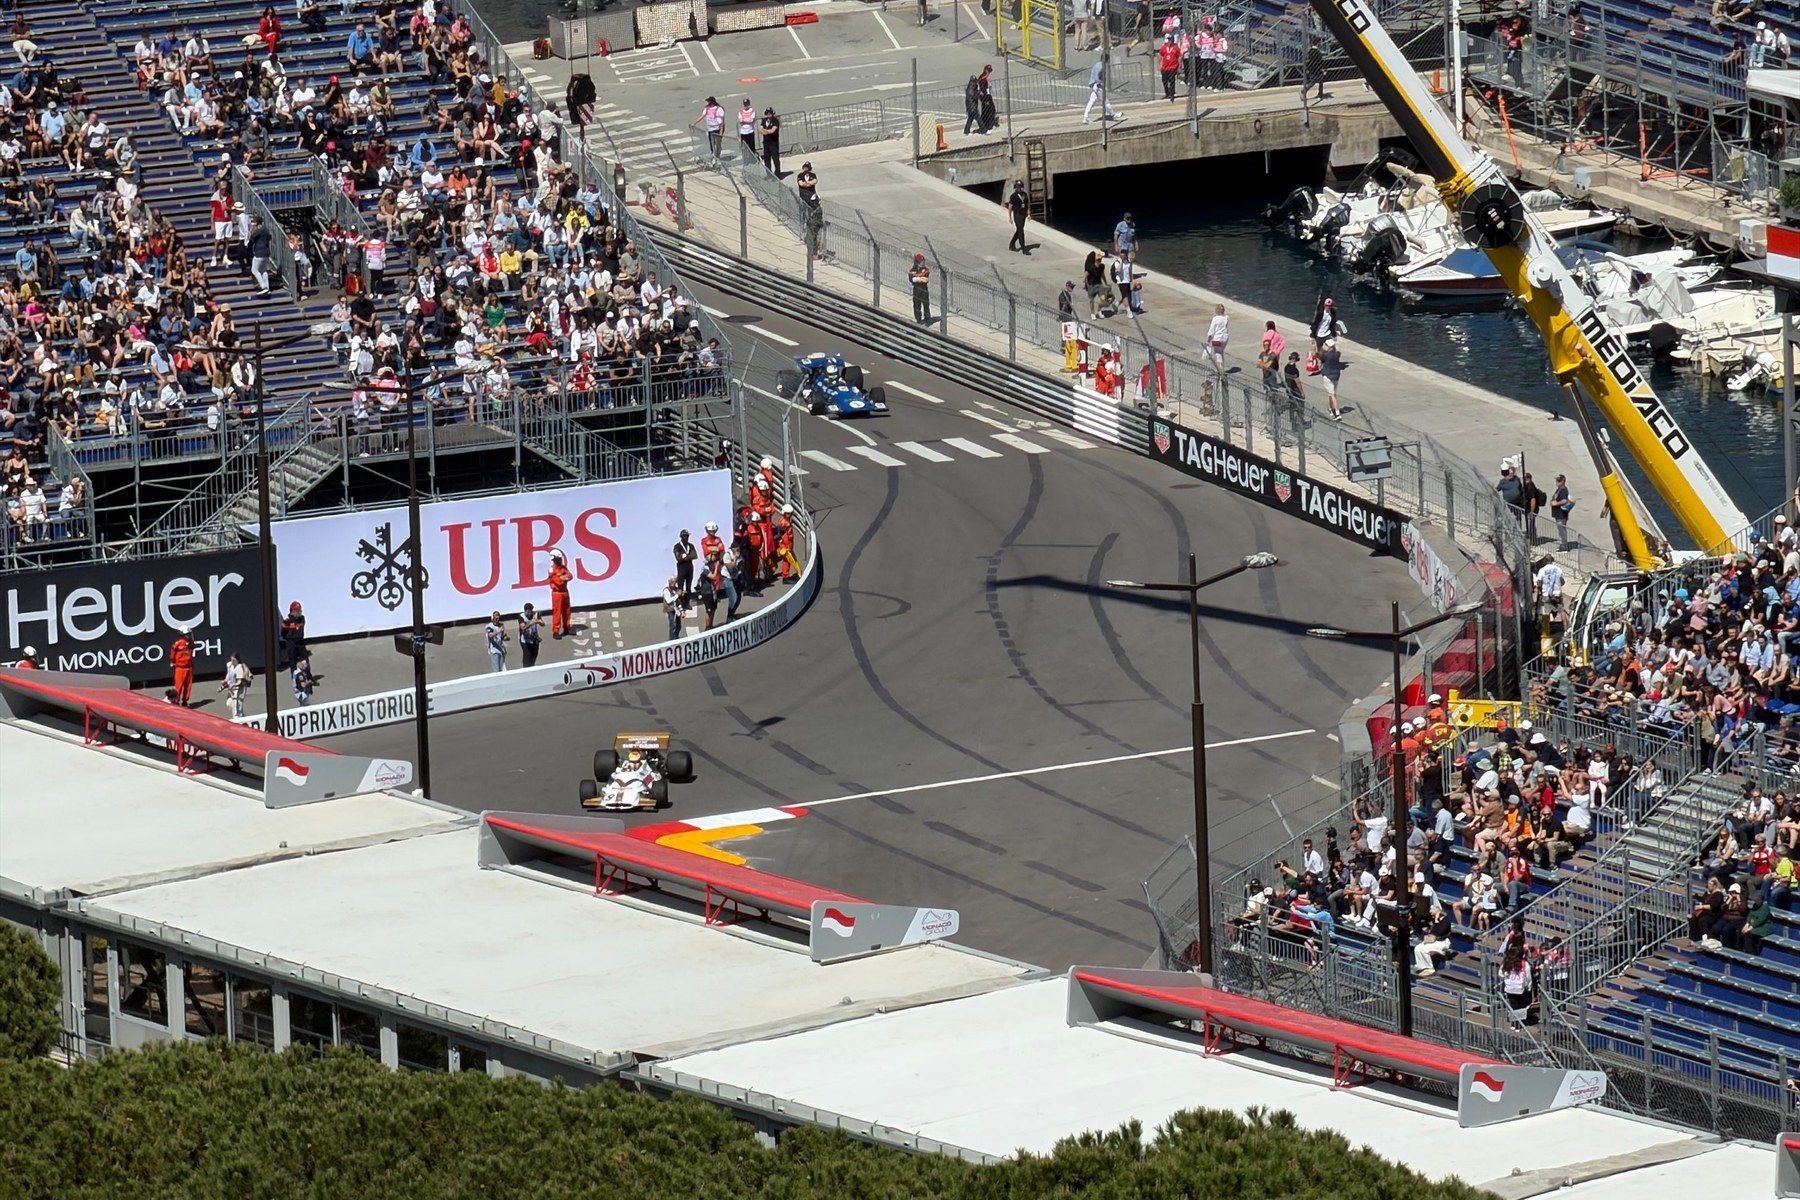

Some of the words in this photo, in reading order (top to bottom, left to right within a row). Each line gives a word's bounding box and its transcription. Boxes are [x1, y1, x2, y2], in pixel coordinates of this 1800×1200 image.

[1154, 421, 1170, 437] TAG
[440, 507, 622, 595] UBS
[8, 572, 244, 648] Heuer
[59, 644, 163, 672] MONACO
[622, 645, 683, 678] MONACO
[300, 707, 338, 734] PRIX
[340, 688, 434, 728] HISTORIQE
